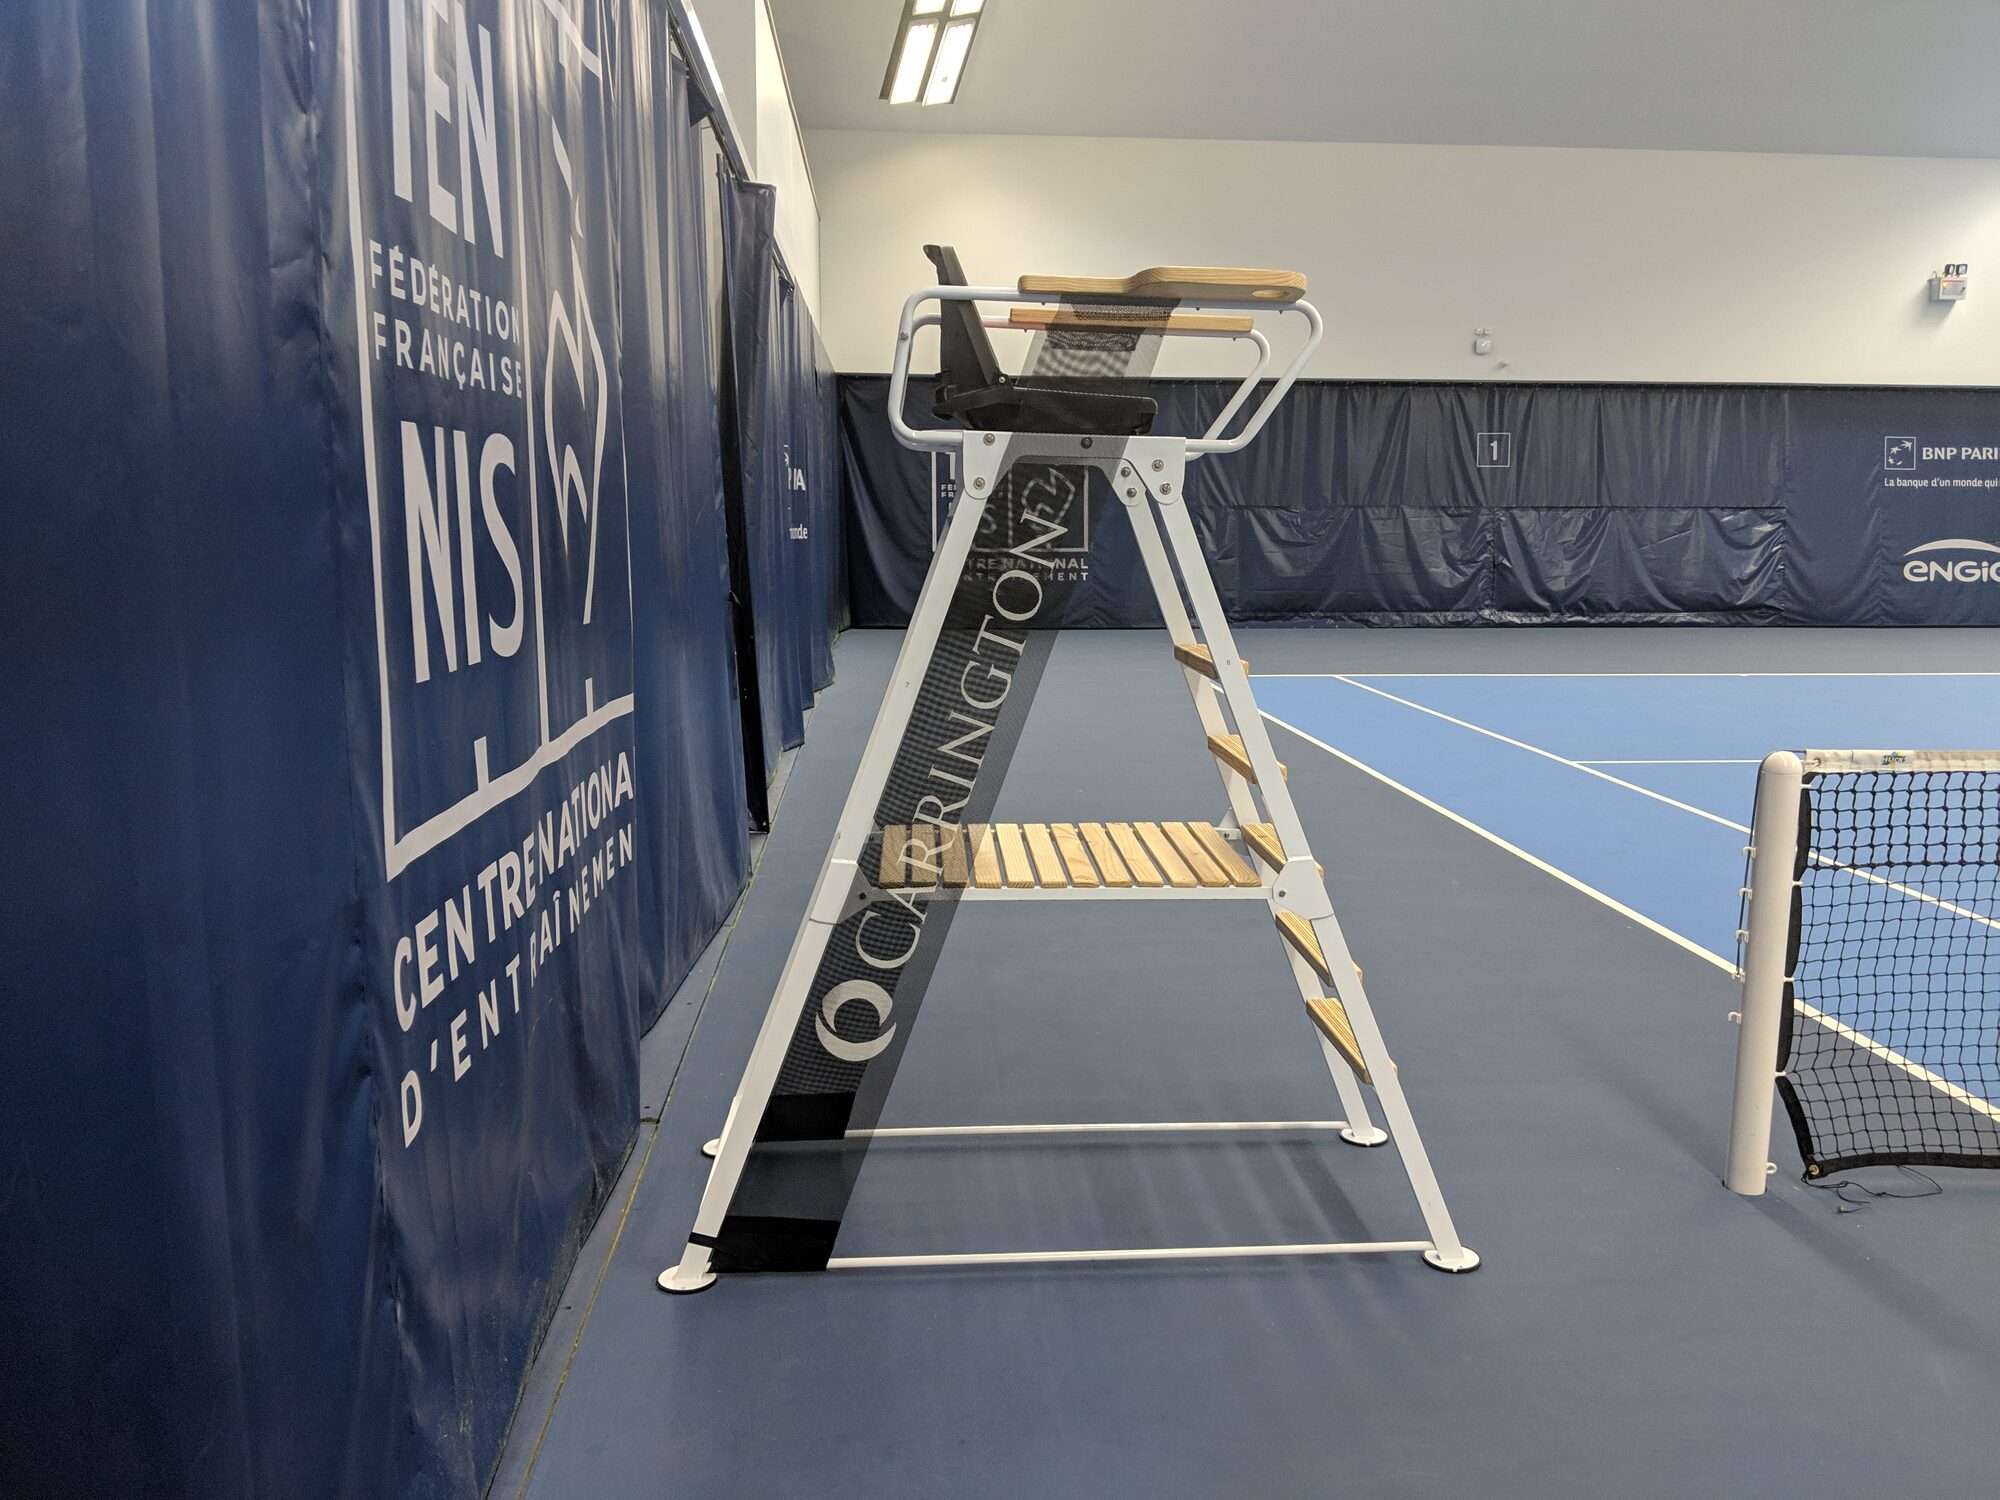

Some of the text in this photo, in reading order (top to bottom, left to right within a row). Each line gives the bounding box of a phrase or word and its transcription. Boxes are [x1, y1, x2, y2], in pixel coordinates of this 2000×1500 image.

[369, 239, 520, 346] FÉDÉRATION
[373, 311, 523, 399] FRANÇAISE
[1490, 440, 1498, 461] 1
[1884, 478, 1895, 487] La
[1896, 477, 1929, 489] banque
[1952, 478, 1984, 487] monde
[1984, 478, 1998, 489] qui
[1922, 447, 2000, 460] BNP PARI
[401, 420, 524, 683] NIS
[855, 510, 1068, 969] CARRINGTON
